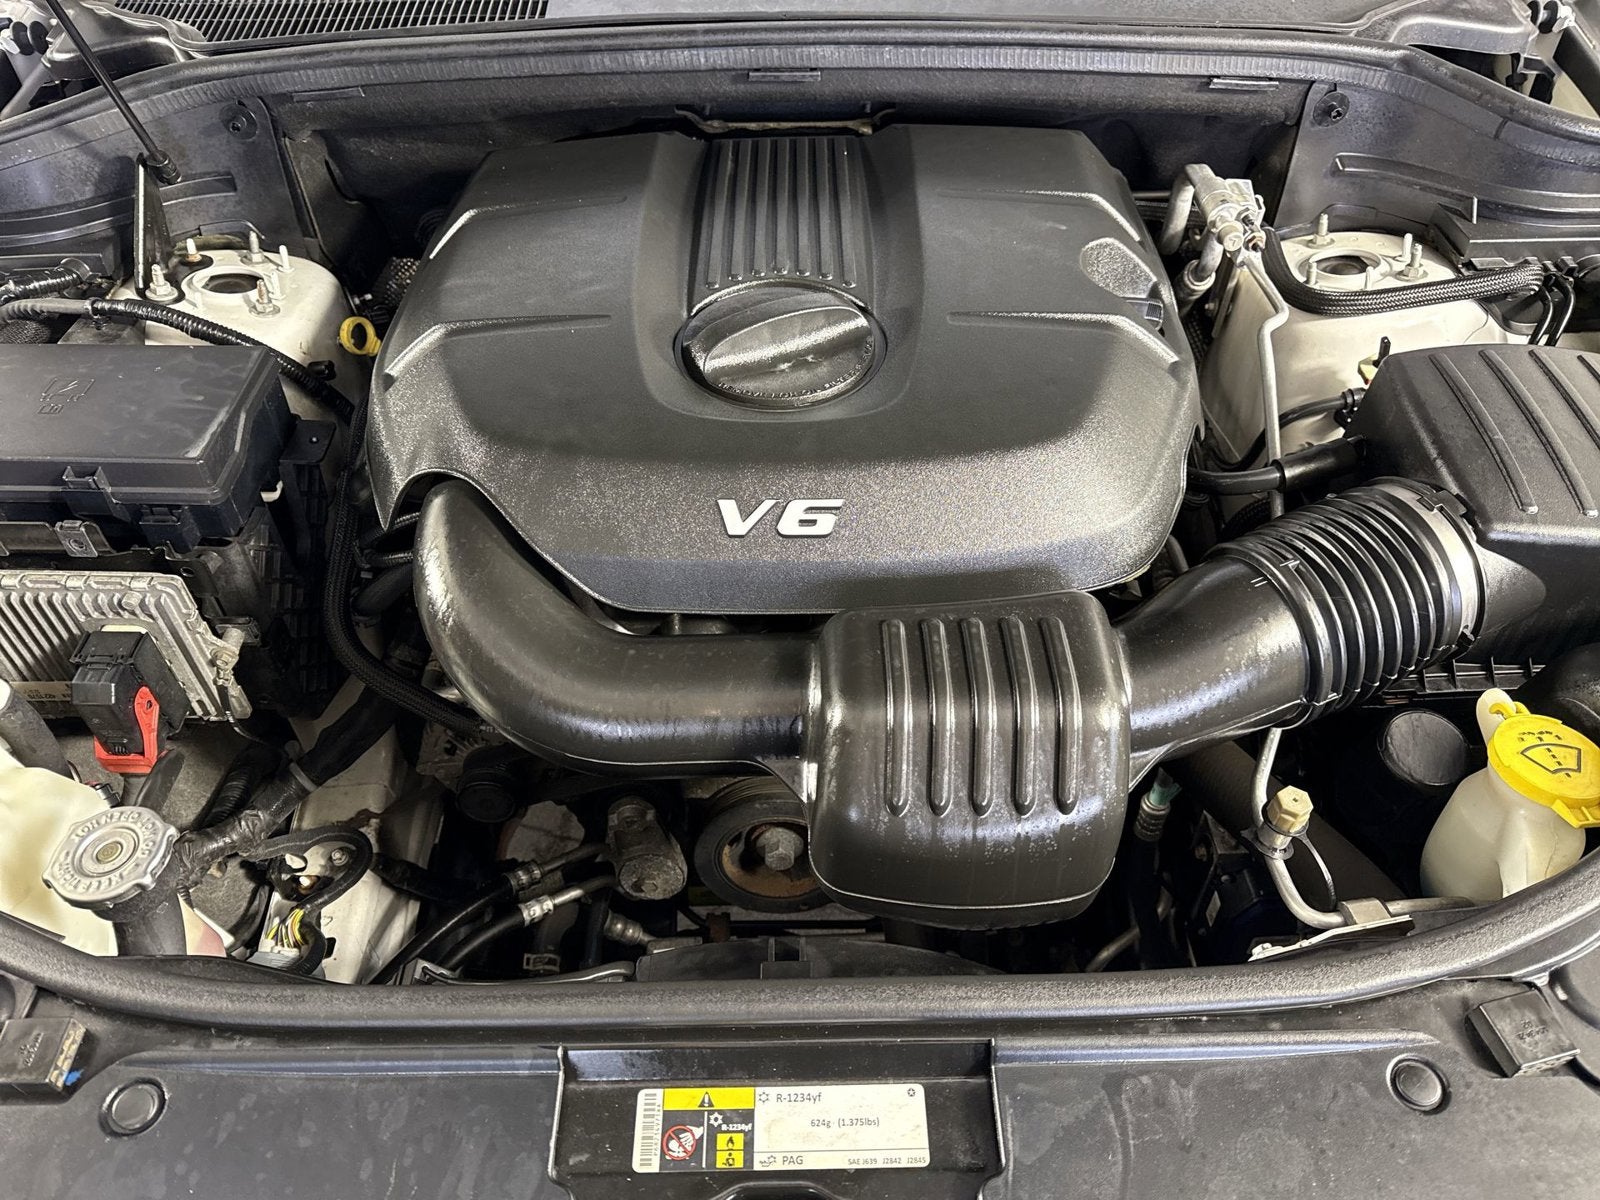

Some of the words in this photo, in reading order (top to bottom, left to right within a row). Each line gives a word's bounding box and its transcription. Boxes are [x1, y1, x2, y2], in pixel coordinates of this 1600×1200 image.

[717, 498, 845, 538] V6
[102, 811, 141, 824] OPEN
[74, 818, 100, 841] HOT
[139, 816, 159, 839] NOT
[141, 841, 156, 857] DO
[83, 871, 125, 891] KEEP
[776, 1092, 823, 1104] R-1234yf
[721, 1123, 753, 1132] R-1234yf
[810, 1117, 832, 1128] 624g
[838, 1116, 881, 1127] (1.375lbs)
[782, 1155, 804, 1166] PAG
[863, 1157, 877, 1166] J639
[882, 1156, 902, 1165] J2842
